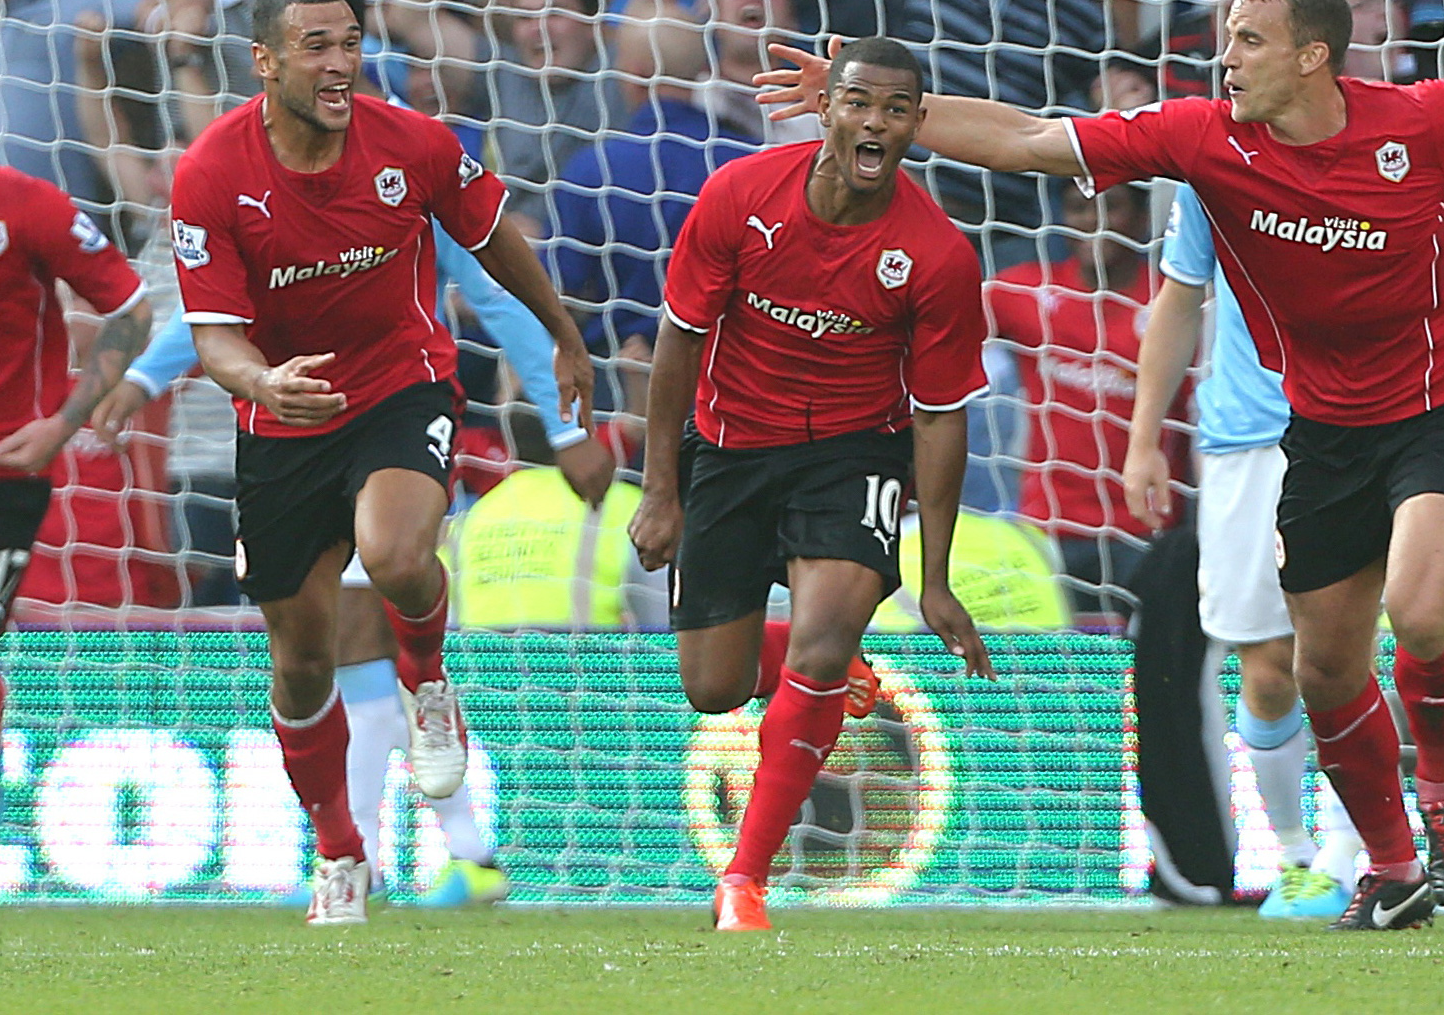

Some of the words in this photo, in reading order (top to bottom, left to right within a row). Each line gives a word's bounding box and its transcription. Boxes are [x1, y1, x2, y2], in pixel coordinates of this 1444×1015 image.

[1249, 208, 1388, 253] Malaysia
[1323, 216, 1360, 231] visit
[268, 246, 399, 290] Malaysia
[339, 245, 375, 264] visit
[746, 291, 876, 340] Malaysia
[816, 308, 852, 326] visit
[425, 414, 454, 456] 4
[860, 474, 902, 536] 10
